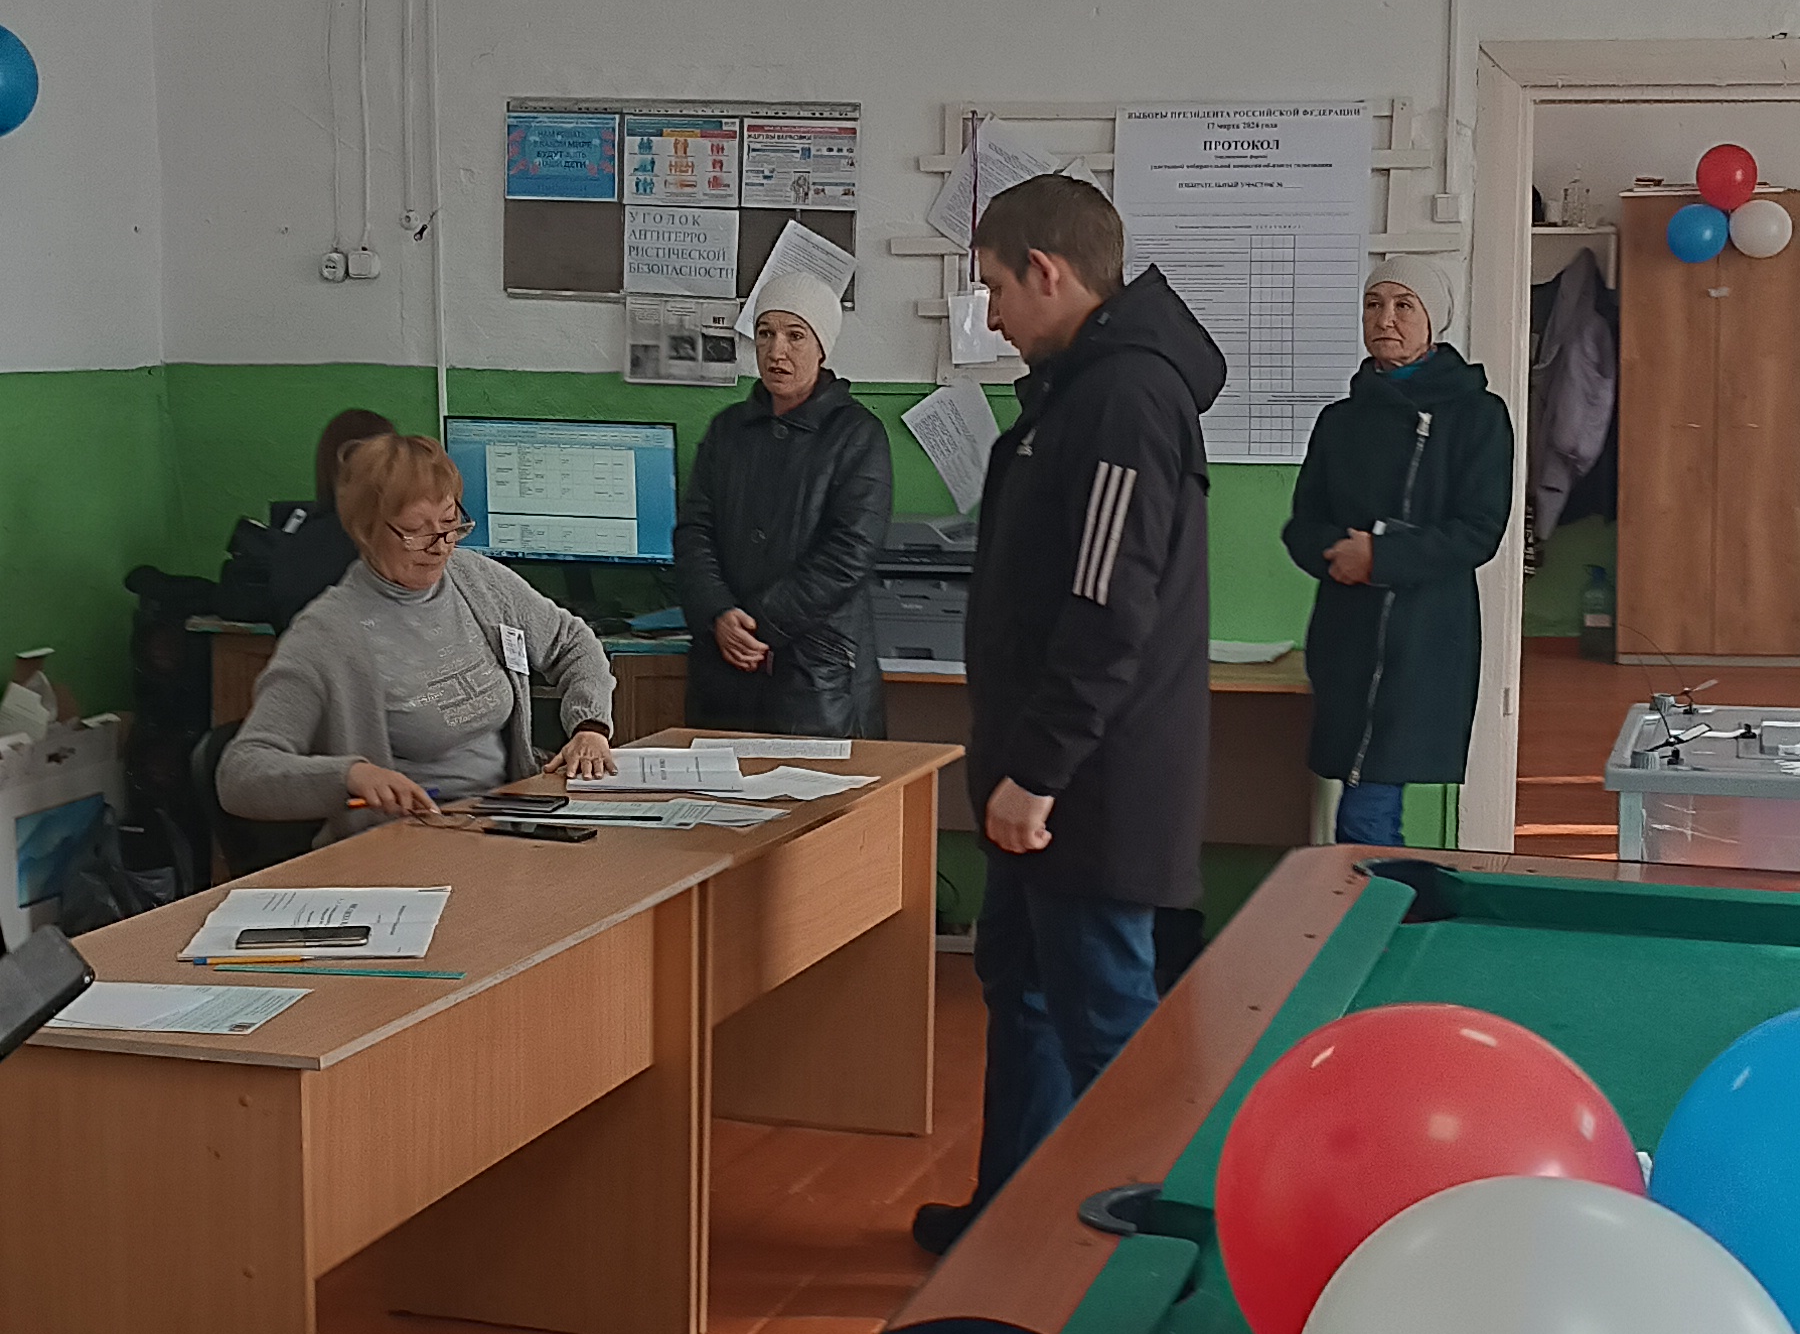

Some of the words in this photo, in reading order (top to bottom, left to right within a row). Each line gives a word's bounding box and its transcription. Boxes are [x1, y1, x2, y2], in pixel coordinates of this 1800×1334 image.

[1127, 110, 1168, 119] ВЫБОРЫ
[1170, 109, 1231, 119] ПРЕЗИДЕНТА
[1233, 108, 1300, 118] РОССИЙСКОЙ
[1302, 108, 1361, 117] ФЕДЕРАЦИИ
[1203, 139, 1280, 151] ПРОТОКОЛ
[628, 210, 702, 227] УГОЛОК
[628, 229, 708, 244] АНТИТЕРРО
[627, 245, 727, 262] РИСТИЧЕСКОЙ
[628, 262, 735, 280] БЕЗОПАСНОСТИ
